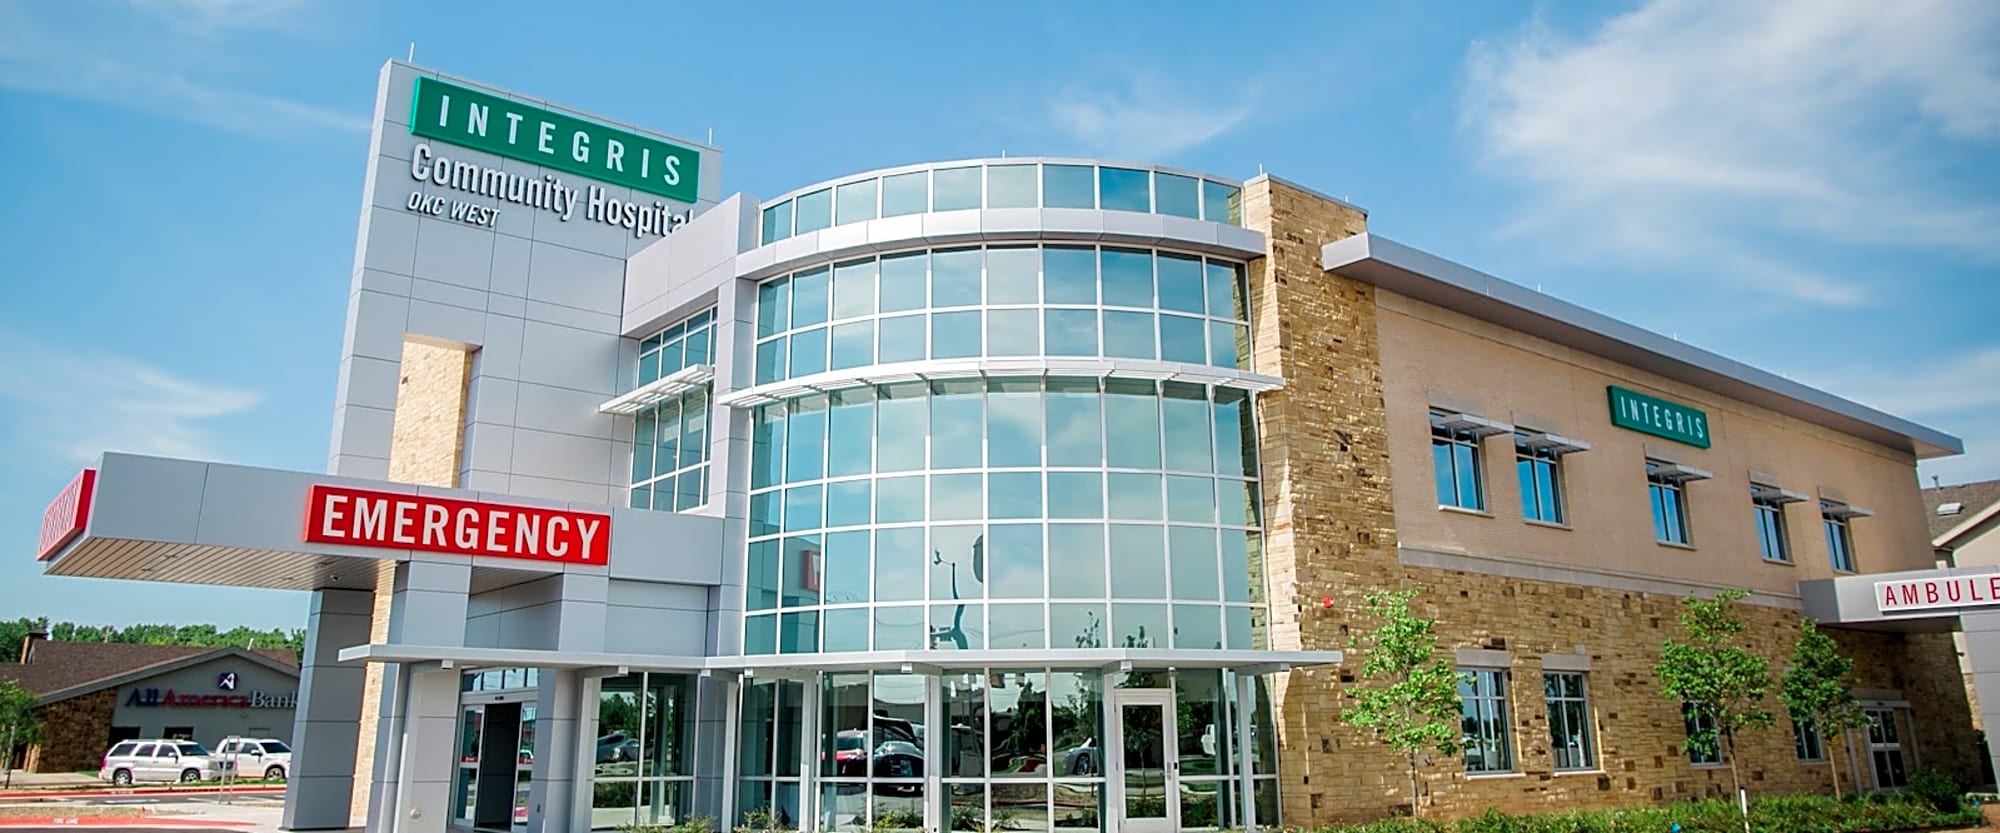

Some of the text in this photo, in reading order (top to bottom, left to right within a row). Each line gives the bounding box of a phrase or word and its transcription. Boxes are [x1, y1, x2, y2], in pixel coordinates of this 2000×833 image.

[439, 95, 680, 186] INTEGRIS
[407, 191, 500, 227] OKC WEST
[411, 143, 579, 221] Community
[1620, 396, 1704, 439] INTEGRIS
[322, 494, 600, 559] EMERGENCY
